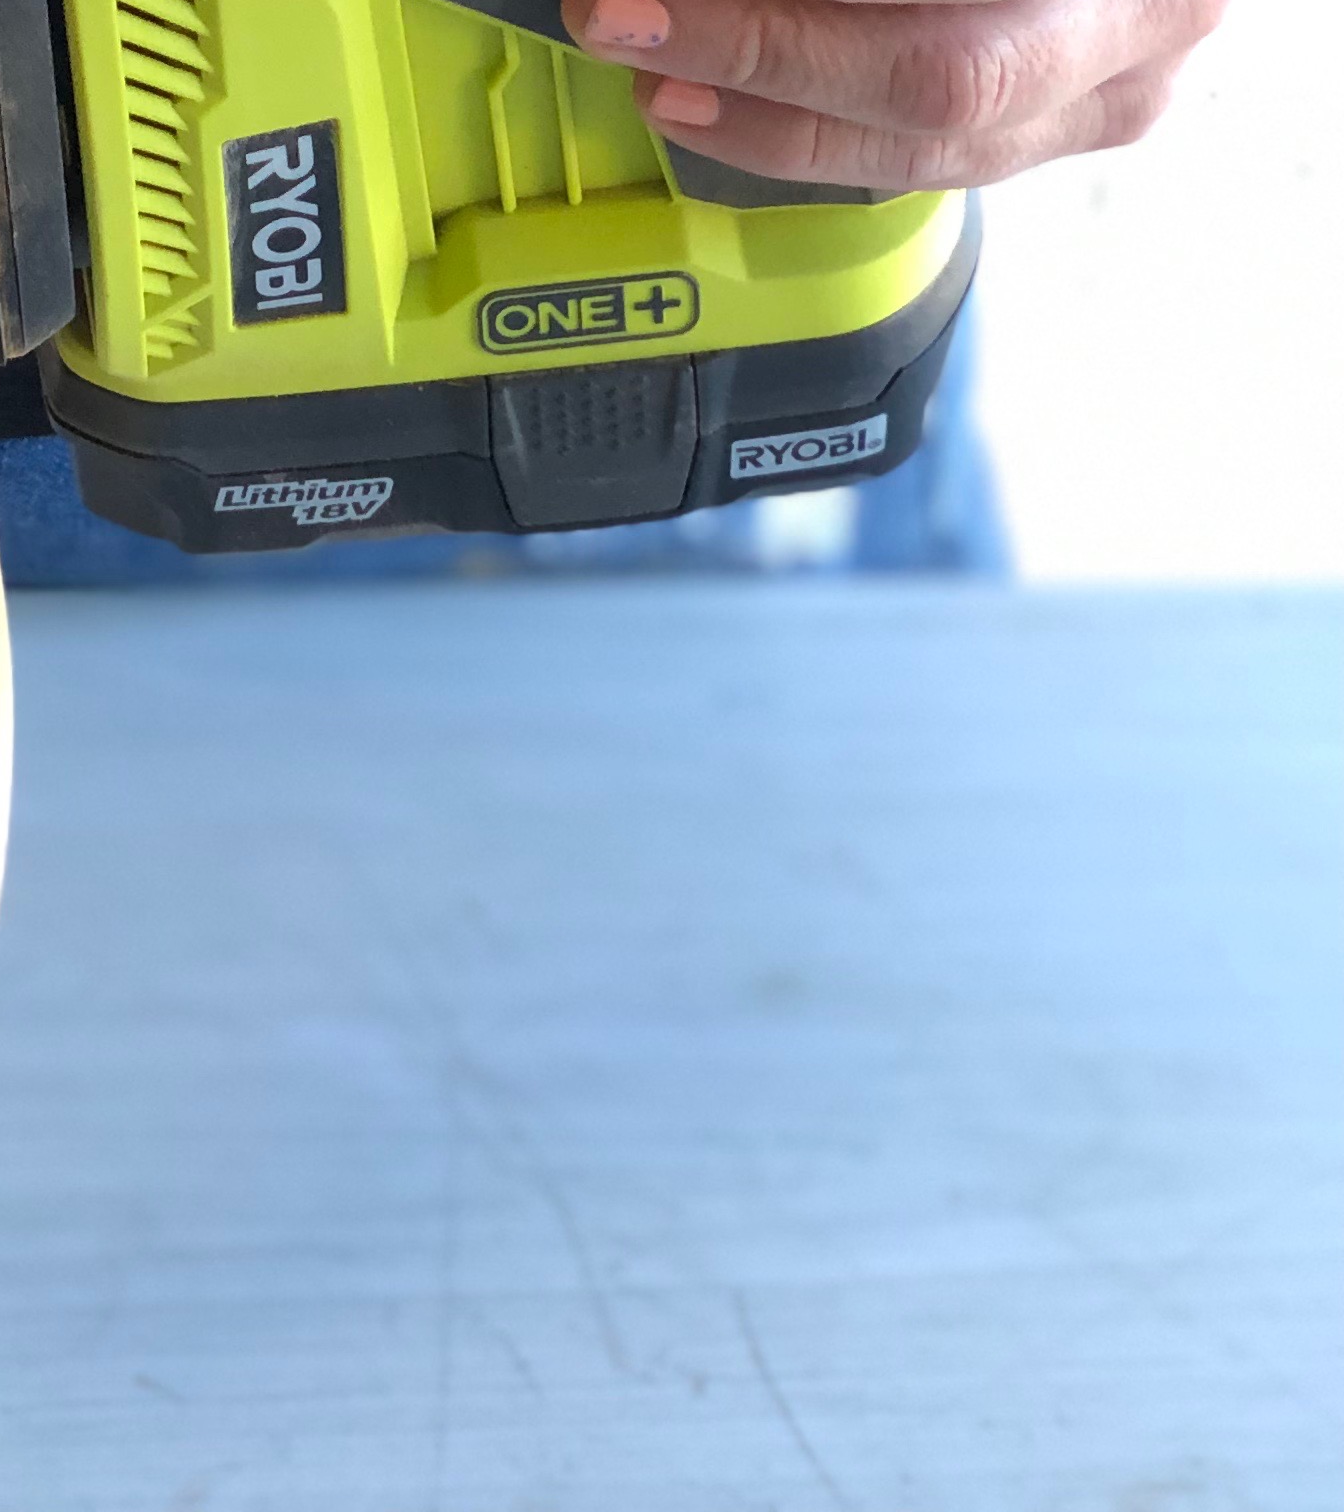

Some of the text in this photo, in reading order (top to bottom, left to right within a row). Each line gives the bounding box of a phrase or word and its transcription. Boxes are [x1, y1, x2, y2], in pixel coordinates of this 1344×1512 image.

[246, 135, 323, 310] RYOBI
[736, 428, 868, 470] RYOBI
[220, 480, 389, 508] Lithium
[301, 499, 380, 521] 18V
